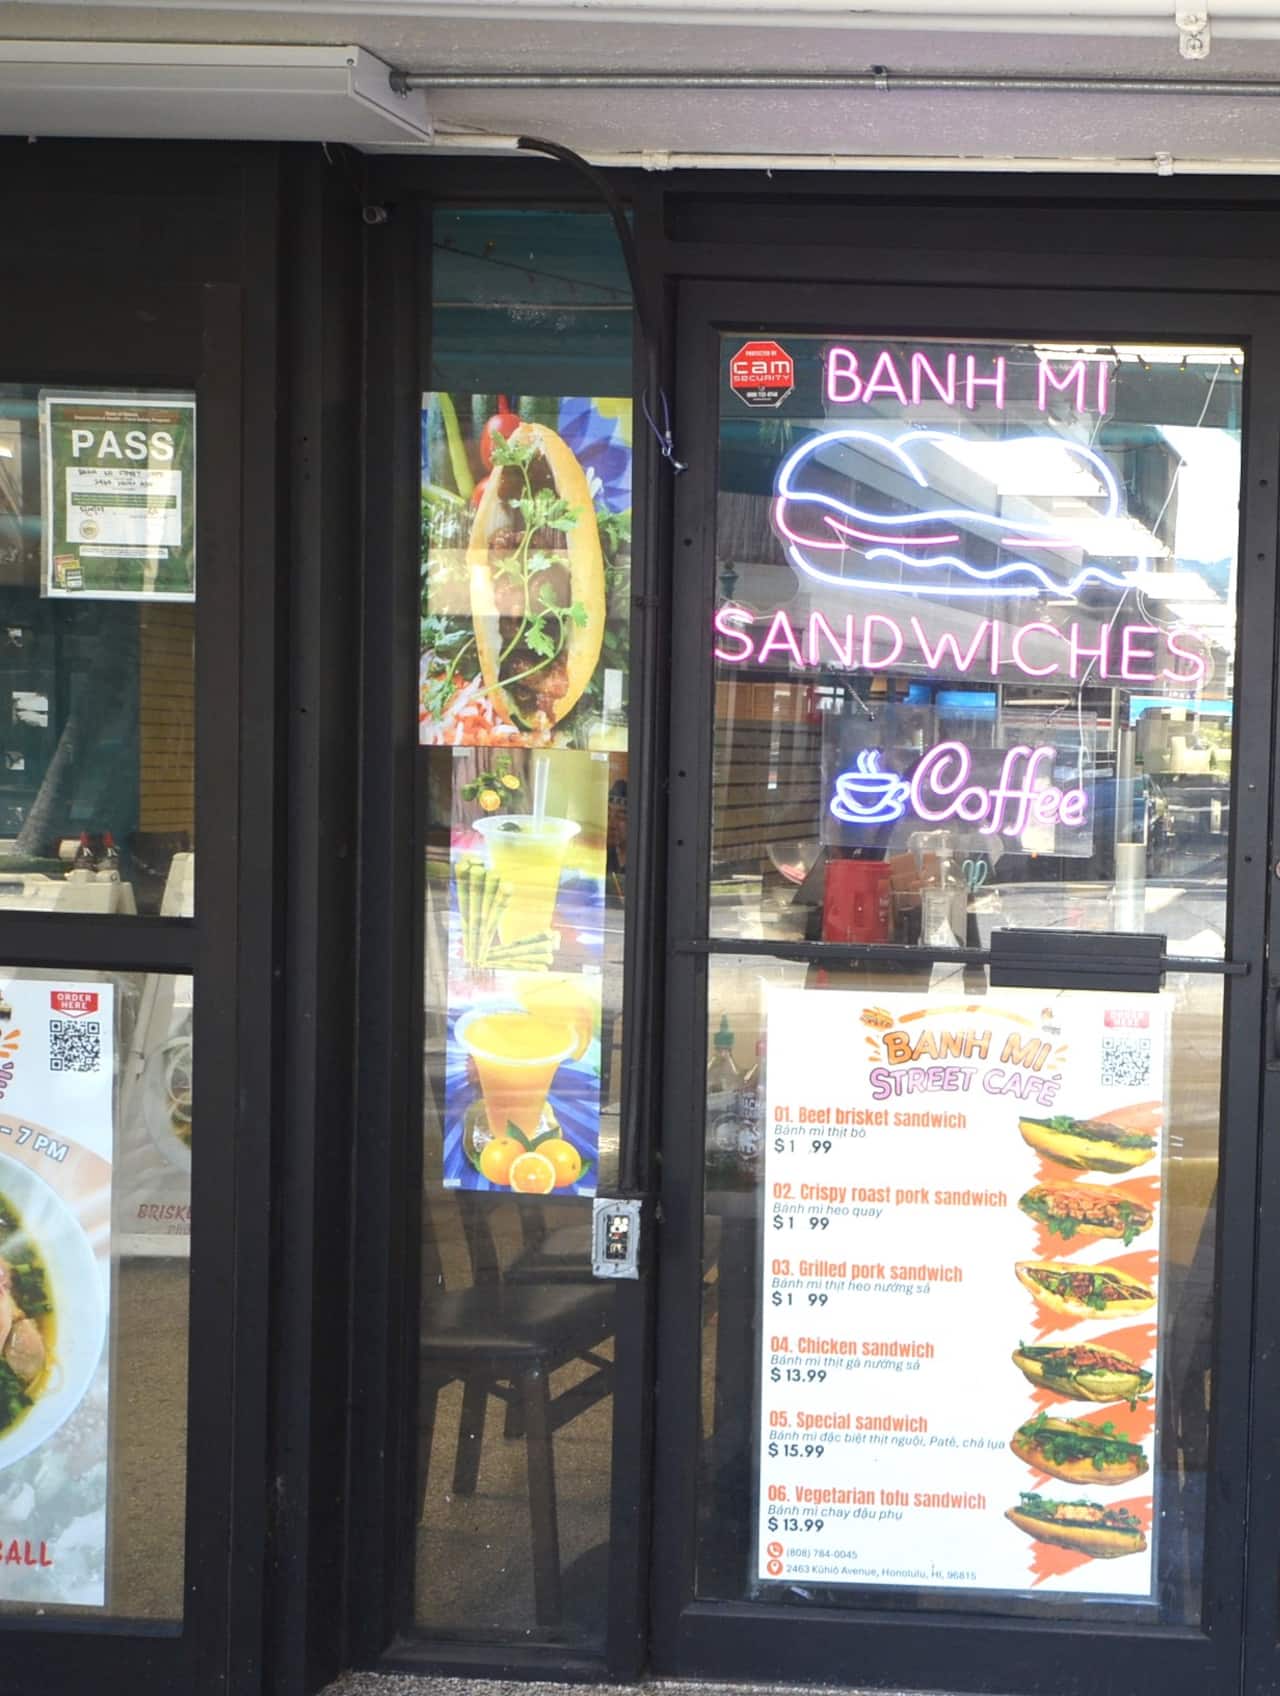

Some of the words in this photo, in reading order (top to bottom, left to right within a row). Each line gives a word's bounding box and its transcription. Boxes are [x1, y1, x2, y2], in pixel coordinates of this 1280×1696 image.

[733, 361, 790, 375] cam
[825, 346, 1006, 411] BANH
[1039, 358, 1108, 416] MI
[71, 429, 175, 461] PASS
[713, 607, 1211, 683] SANDWICHES
[911, 741, 1087, 836] Coffee
[57, 993, 91, 1002] ORDER
[60, 1001, 89, 1009] HERE
[883, 1029, 992, 1066] BANH
[1000, 1032, 1052, 1071] MI
[869, 1066, 979, 1100] STREET
[982, 1069, 1062, 1107] CAFÉ
[774, 1105, 793, 1123] 01.
[799, 1107, 831, 1124] Beef
[836, 1108, 889, 1126] brisket
[893, 1111, 967, 1129] sandwich
[34, 1136, 71, 1163] PM
[773, 1183, 796, 1200] 02.
[800, 1184, 846, 1203] Crispy
[852, 1187, 891, 1203] roast
[895, 1187, 930, 1206] pork
[934, 1190, 1008, 1207] sandwich
[826, 1205, 850, 1216] heo
[852, 1207, 883, 1218] quay
[771, 1259, 794, 1277] 03.
[799, 1260, 847, 1278] Grilled
[851, 1263, 886, 1281] pork
[890, 1264, 963, 1283] sandwich
[848, 1280, 871, 1292] heo
[770, 1336, 793, 1353] 04.
[798, 1337, 857, 1356] Chicken
[862, 1339, 935, 1359] sandwich
[769, 1410, 792, 1428] 05.
[796, 1411, 851, 1431] Special
[855, 1413, 928, 1433] sandwich
[767, 1484, 790, 1502] 06.
[795, 1486, 875, 1505] Vegetarian
[880, 1489, 909, 1507] tofu
[913, 1491, 987, 1510] sandwich
[821, 1507, 851, 1520] chay
[0, 1539, 53, 1567] ALL
[786, 1547, 811, 1559] (808)
[814, 1548, 858, 1560] 784-0045
[786, 1564, 810, 1574] 2463
[841, 1566, 880, 1578] Avenue,
